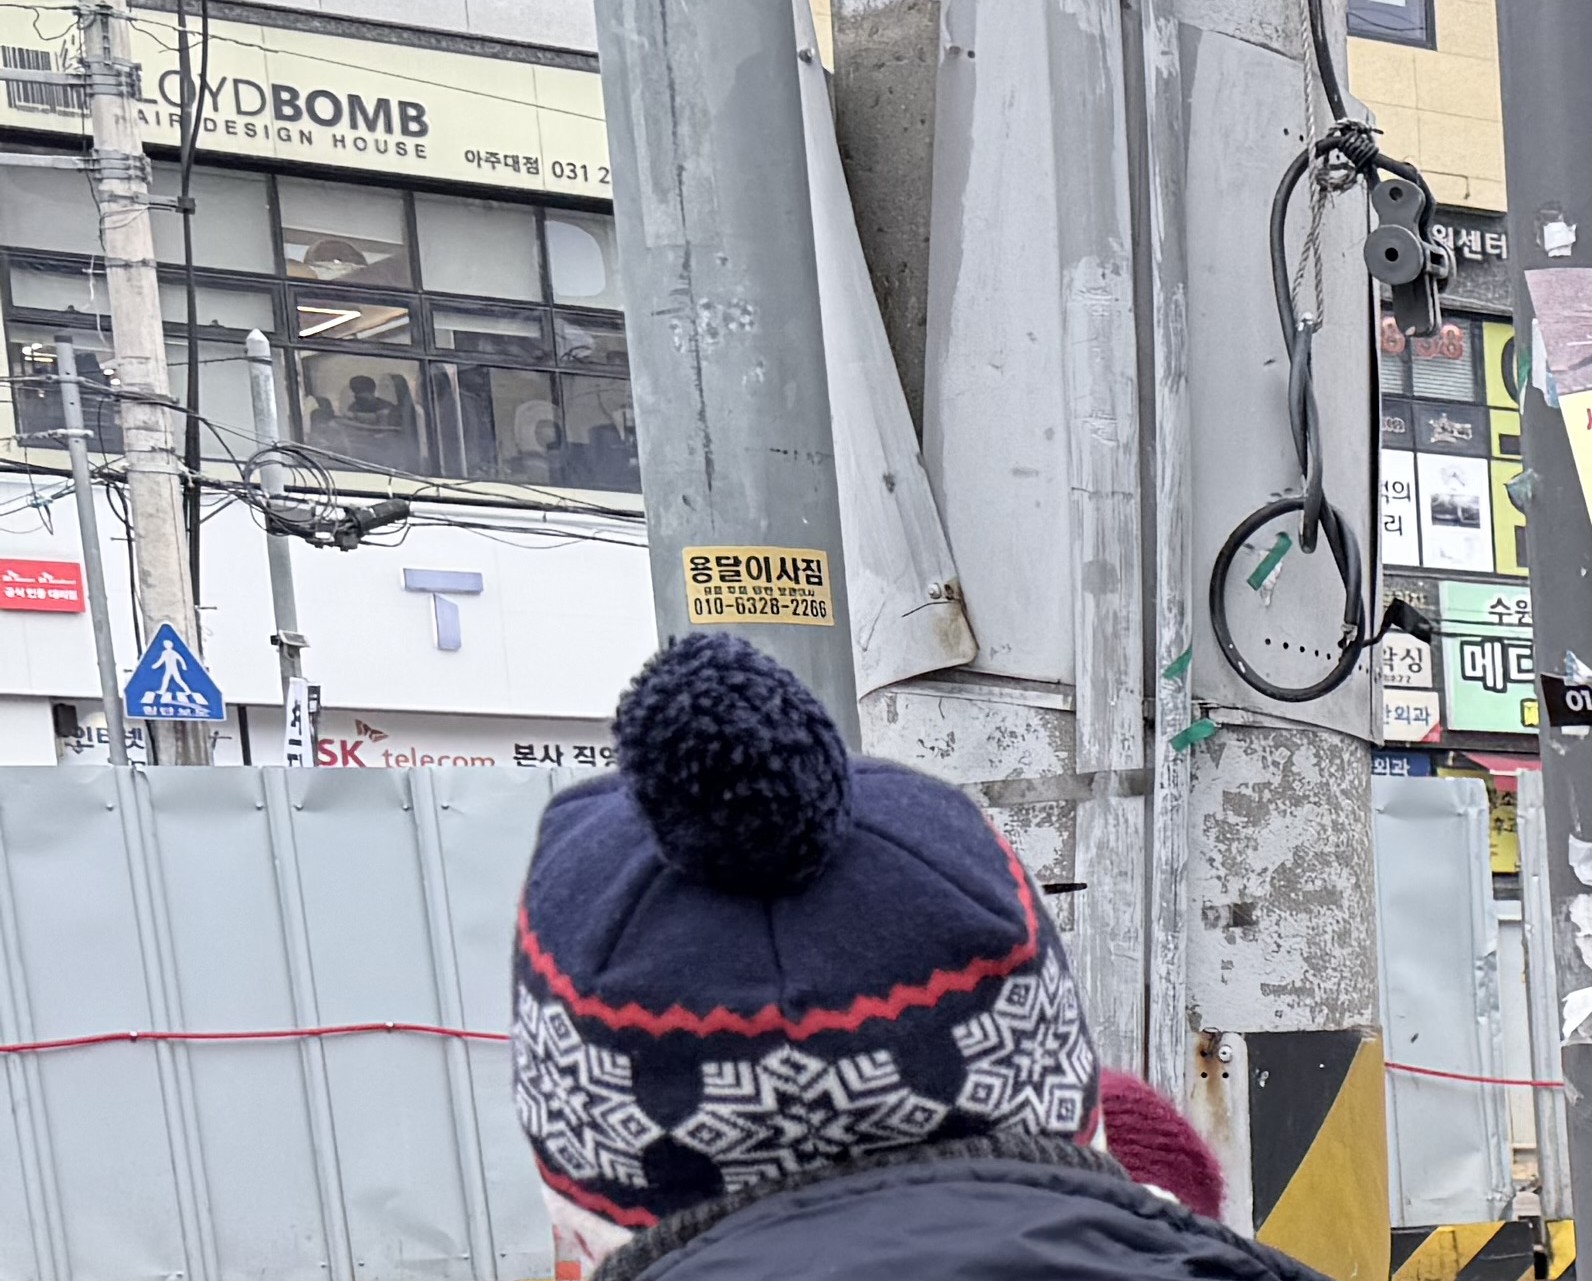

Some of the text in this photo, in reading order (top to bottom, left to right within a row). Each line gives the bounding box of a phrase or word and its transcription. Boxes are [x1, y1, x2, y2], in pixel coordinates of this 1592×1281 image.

[136, 108, 429, 160] AIR DESIGN HOUSE
[464, 147, 541, 177] 아주대점
[551, 160, 589, 184] 031
[689, 555, 824, 586] 용달이사짐
[694, 596, 828, 618] 010-6328-2266
[317, 738, 496, 768] SK telecom
[512, 743, 563, 768] 본사
